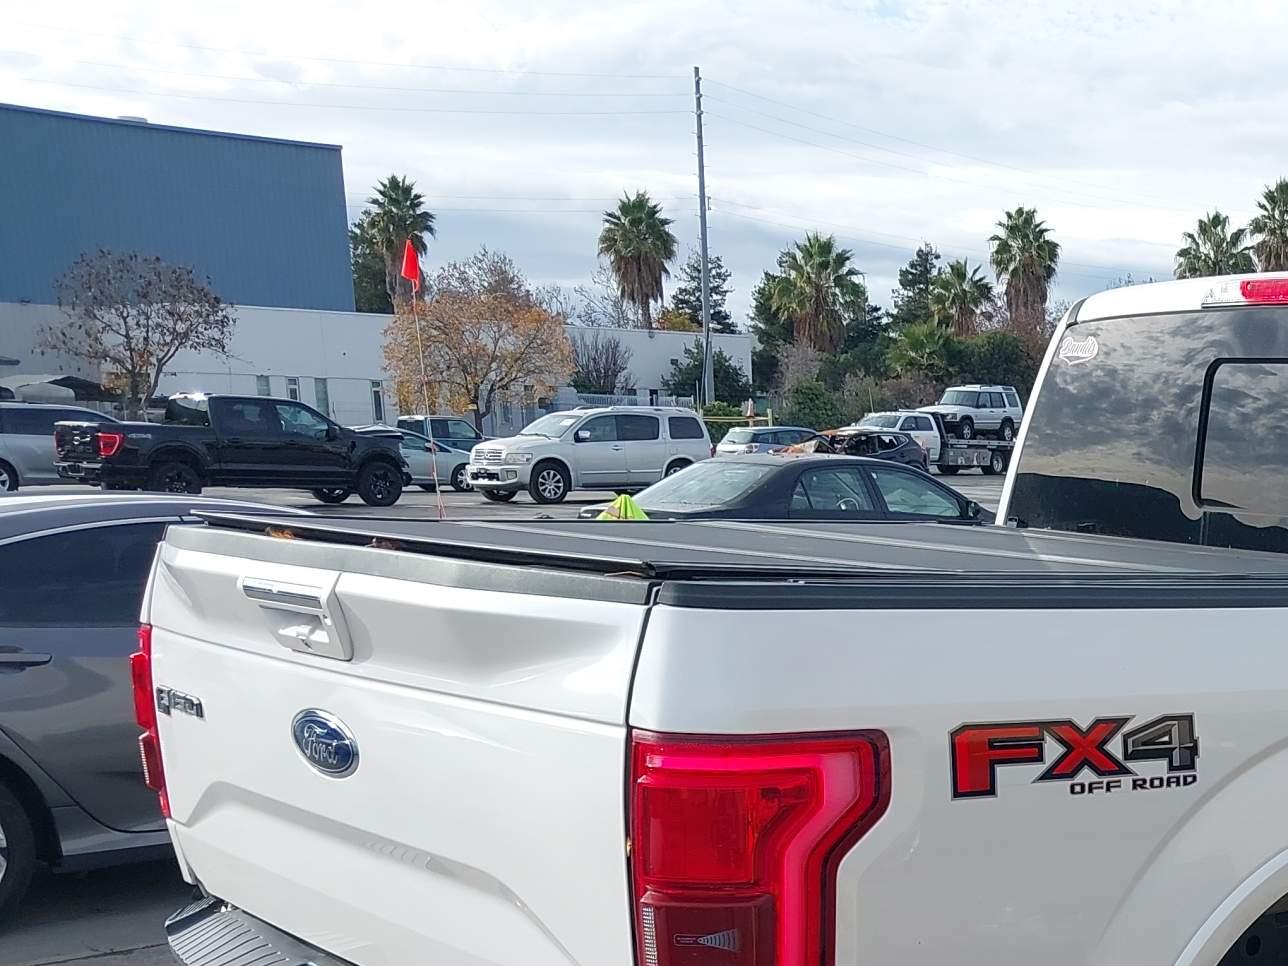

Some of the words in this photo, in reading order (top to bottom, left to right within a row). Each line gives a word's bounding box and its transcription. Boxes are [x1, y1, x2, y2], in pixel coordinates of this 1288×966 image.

[303, 723, 341, 764] Ford
[948, 712, 1200, 800] FX4
[1069, 780, 1122, 796] OFF
[1131, 773, 1198, 791] ROAD
